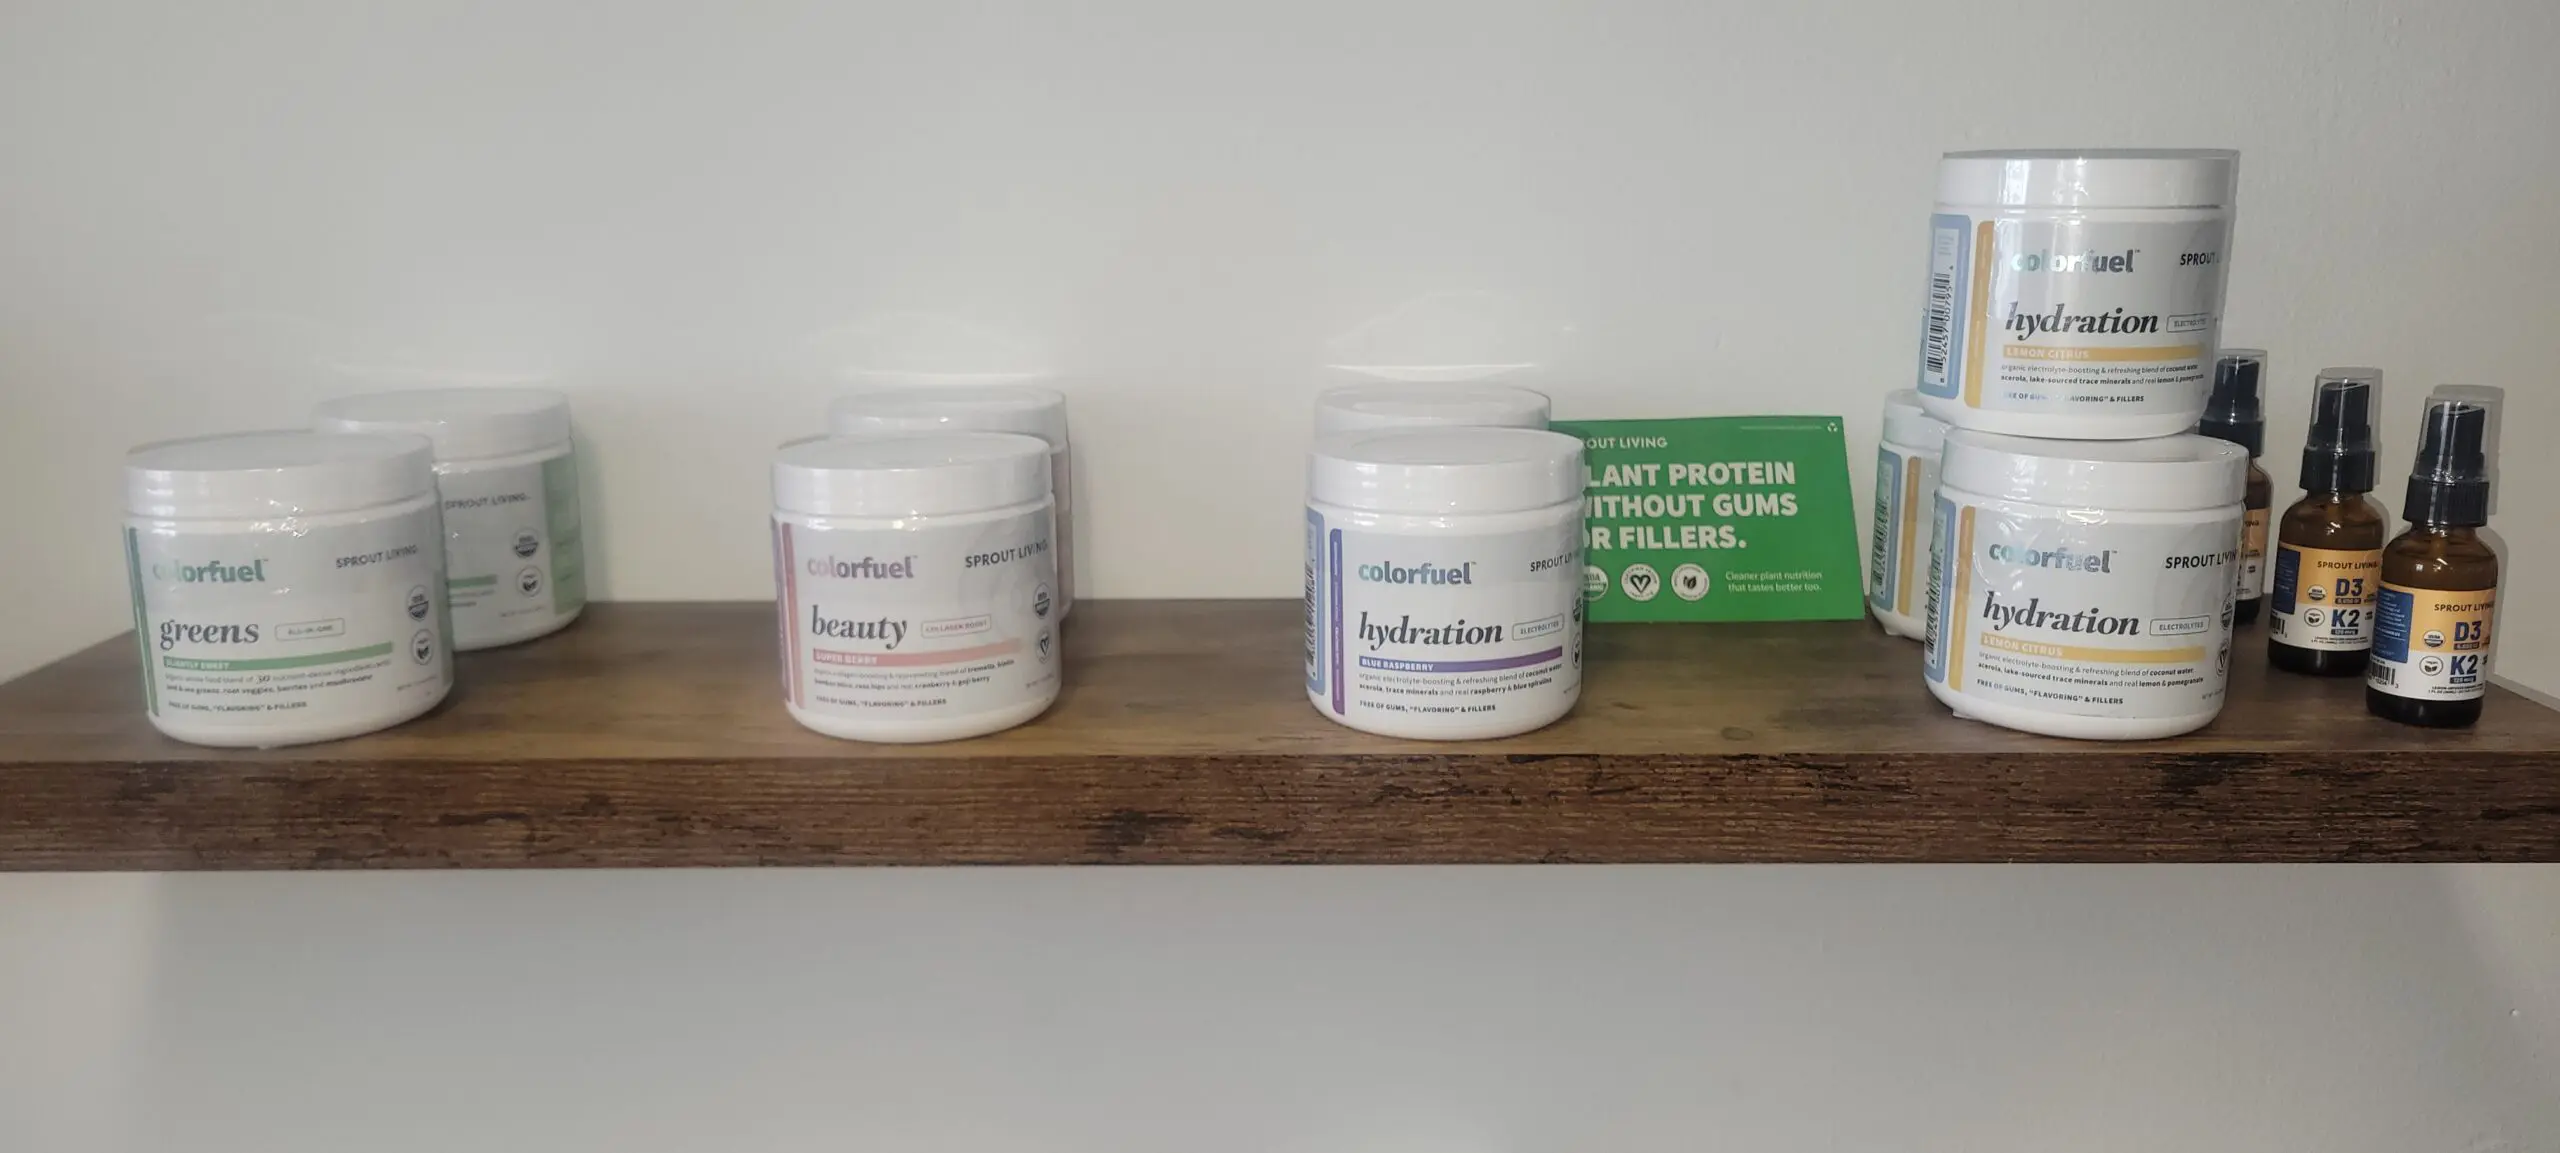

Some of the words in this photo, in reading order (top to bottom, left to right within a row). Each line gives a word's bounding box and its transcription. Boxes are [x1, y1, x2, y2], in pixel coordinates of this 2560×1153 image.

[2180, 252, 2215, 266] SPROUT
[2005, 301, 2159, 341] hydration
[2006, 347, 2045, 358] LEMON
[2047, 348, 2090, 360] CITRUS
[1583, 437, 1615, 449] OUT
[1620, 437, 1668, 449] LIVING
[1585, 463, 1661, 488] LANT
[1668, 461, 1796, 487] PROTEIN
[1712, 492, 1798, 517] GUMS
[1619, 525, 1747, 550] FILLERS.
[336, 551, 383, 570] SPROUT
[965, 548, 1015, 568] SPROUT
[1018, 539, 1048, 559] LIVING
[1530, 554, 1563, 572] SPROUT
[1989, 543, 2111, 574] coorfuel
[2165, 553, 2216, 569] SPROUT
[2216, 549, 2237, 565] LIVIN
[153, 559, 266, 583] clorfuel
[807, 555, 914, 579] colorfuel
[1358, 560, 1472, 585] colorfuel
[2317, 560, 2353, 570] SPROUT
[2354, 560, 2378, 570] LIVING
[1725, 571, 1758, 581] Cleaner
[1760, 571, 1782, 582] plant
[1783, 568, 1822, 580] nutrition
[1728, 583, 1747, 592] that
[1747, 583, 1774, 592] tastes
[1775, 582, 1803, 592] better
[1804, 582, 1822, 592] too.
[2335, 578, 2364, 597] D3
[1983, 590, 2141, 635] hydration
[2434, 603, 2473, 612] SPROUT
[812, 604, 908, 650] beauty
[2158, 621, 2204, 631] ELECTROLYTES
[2331, 609, 2361, 628] K2
[160, 619, 260, 651] greens
[1359, 611, 1504, 651] hydration
[2454, 620, 2482, 642] D3
[1983, 634, 2019, 650] LEMON
[2021, 643, 2063, 657] CITRUS
[1361, 658, 1381, 668] BLUE
[1383, 660, 1434, 672] RASPBERRY
[2082, 666, 2120, 677] refreshing
[2120, 667, 2140, 676] blend
[2141, 667, 2150, 676] of
[2149, 668, 2176, 677] coconut
[2450, 654, 2479, 676] K2
[1462, 675, 1498, 685] refreshing
[2053, 675, 2073, 683] trace
[2074, 677, 2108, 687] minerals
[2109, 679, 2123, 687] and
[2124, 679, 2139, 687] real
[2139, 679, 2161, 687] lemon
[1386, 686, 1404, 694] trace
[1405, 687, 1439, 696] minerals
[1470, 686, 1506, 696] raspberry
[1977, 678, 1992, 689] FREE
[2004, 685, 2028, 697] GUMS,
[2029, 689, 2083, 702] "FLAVORING"
[2092, 696, 2124, 705] FILLERS
[1386, 703, 1408, 713] GUMS,
[1467, 704, 1497, 713] FILLERS
